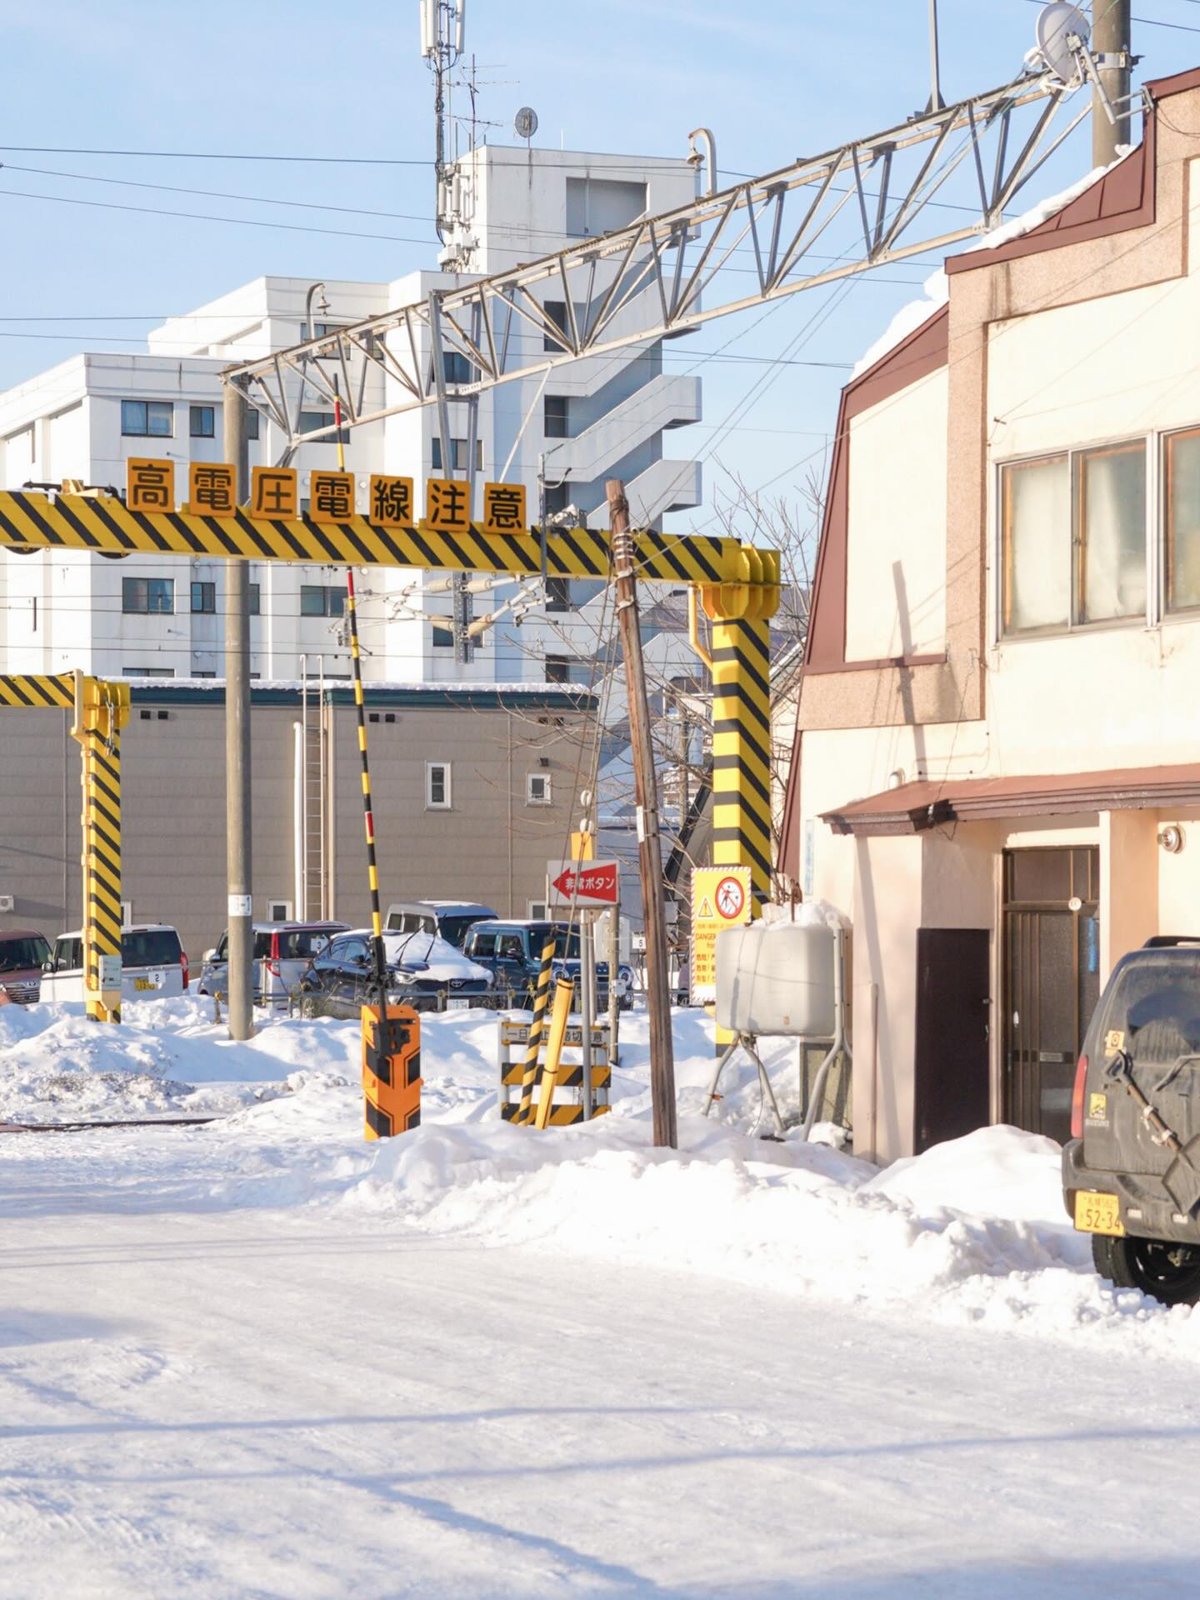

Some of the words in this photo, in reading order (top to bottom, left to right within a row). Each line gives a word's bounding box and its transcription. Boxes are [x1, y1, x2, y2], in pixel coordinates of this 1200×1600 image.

[131, 464, 523, 529] 高電圧電線注意
